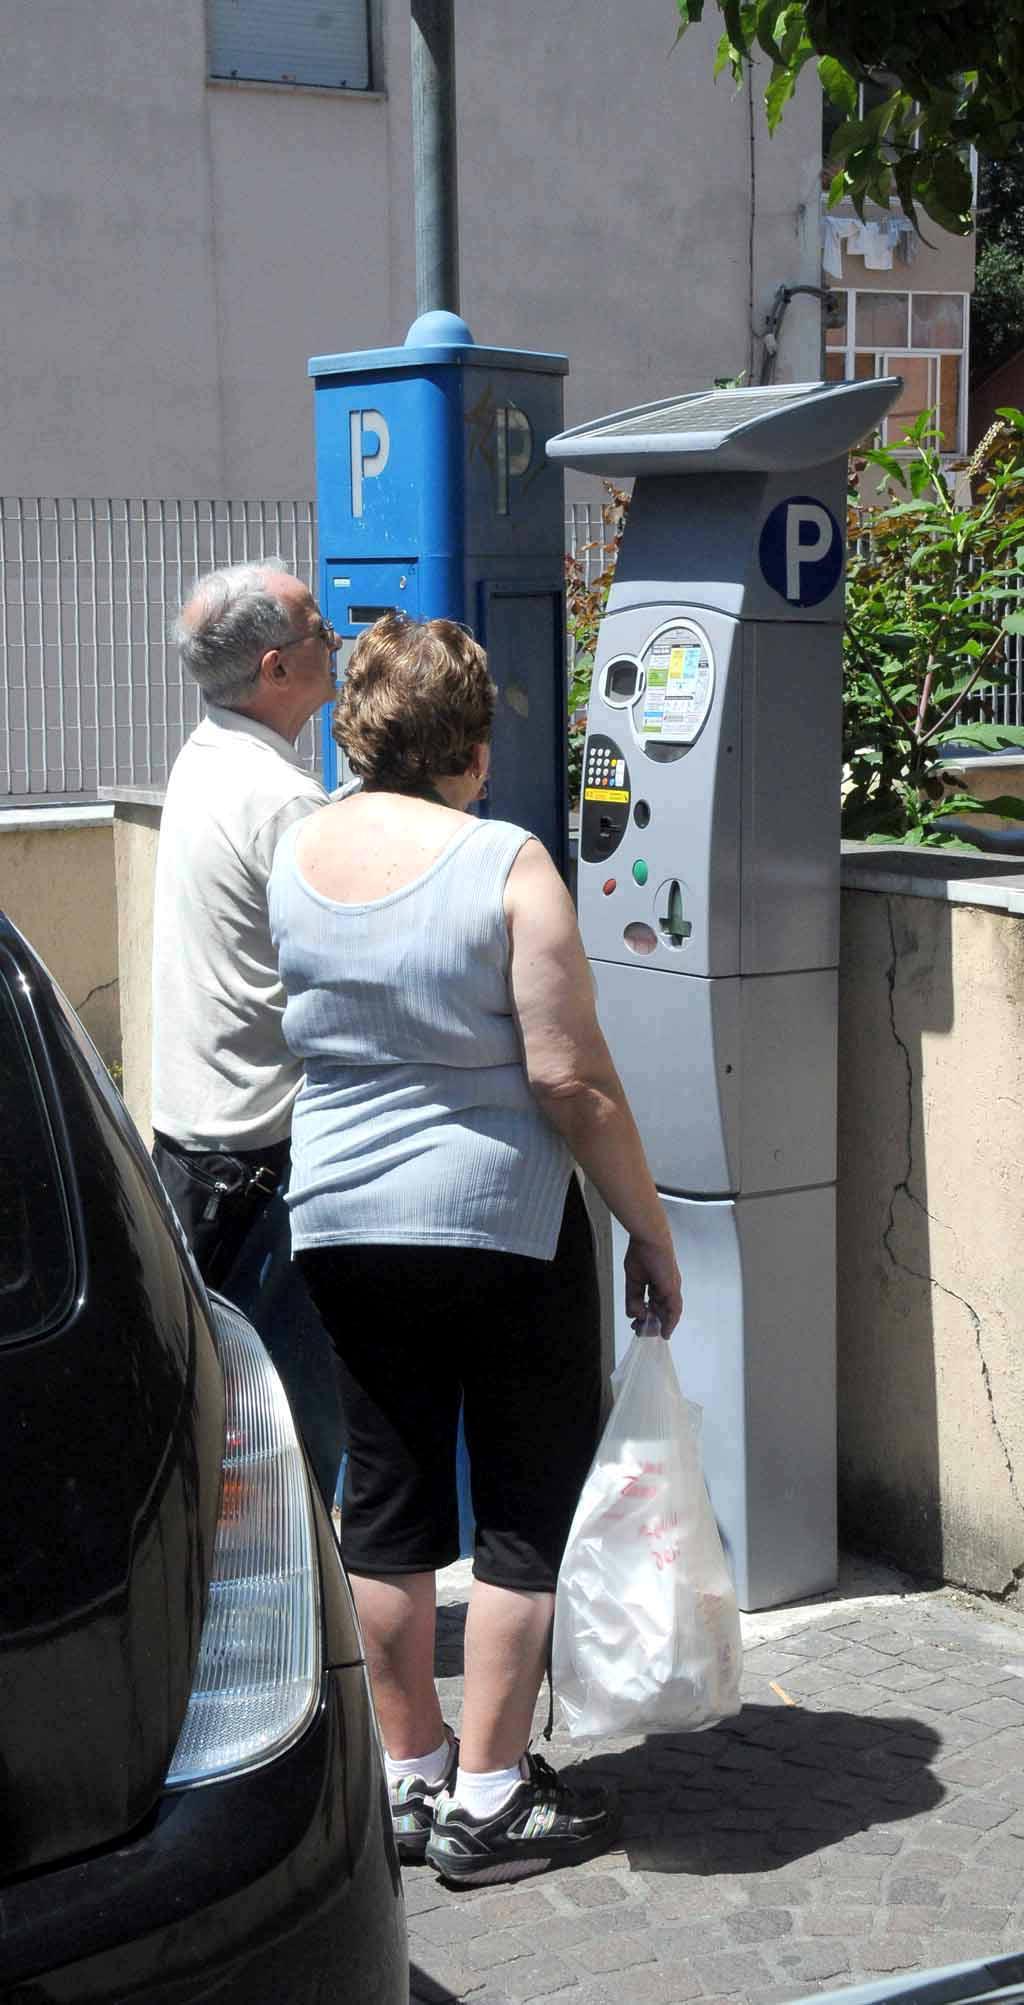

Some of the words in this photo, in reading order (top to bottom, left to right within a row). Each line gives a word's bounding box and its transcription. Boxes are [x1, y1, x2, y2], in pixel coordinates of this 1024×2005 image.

[350, 409, 390, 518] P
[496, 408, 533, 515] P
[786, 504, 833, 600] P
